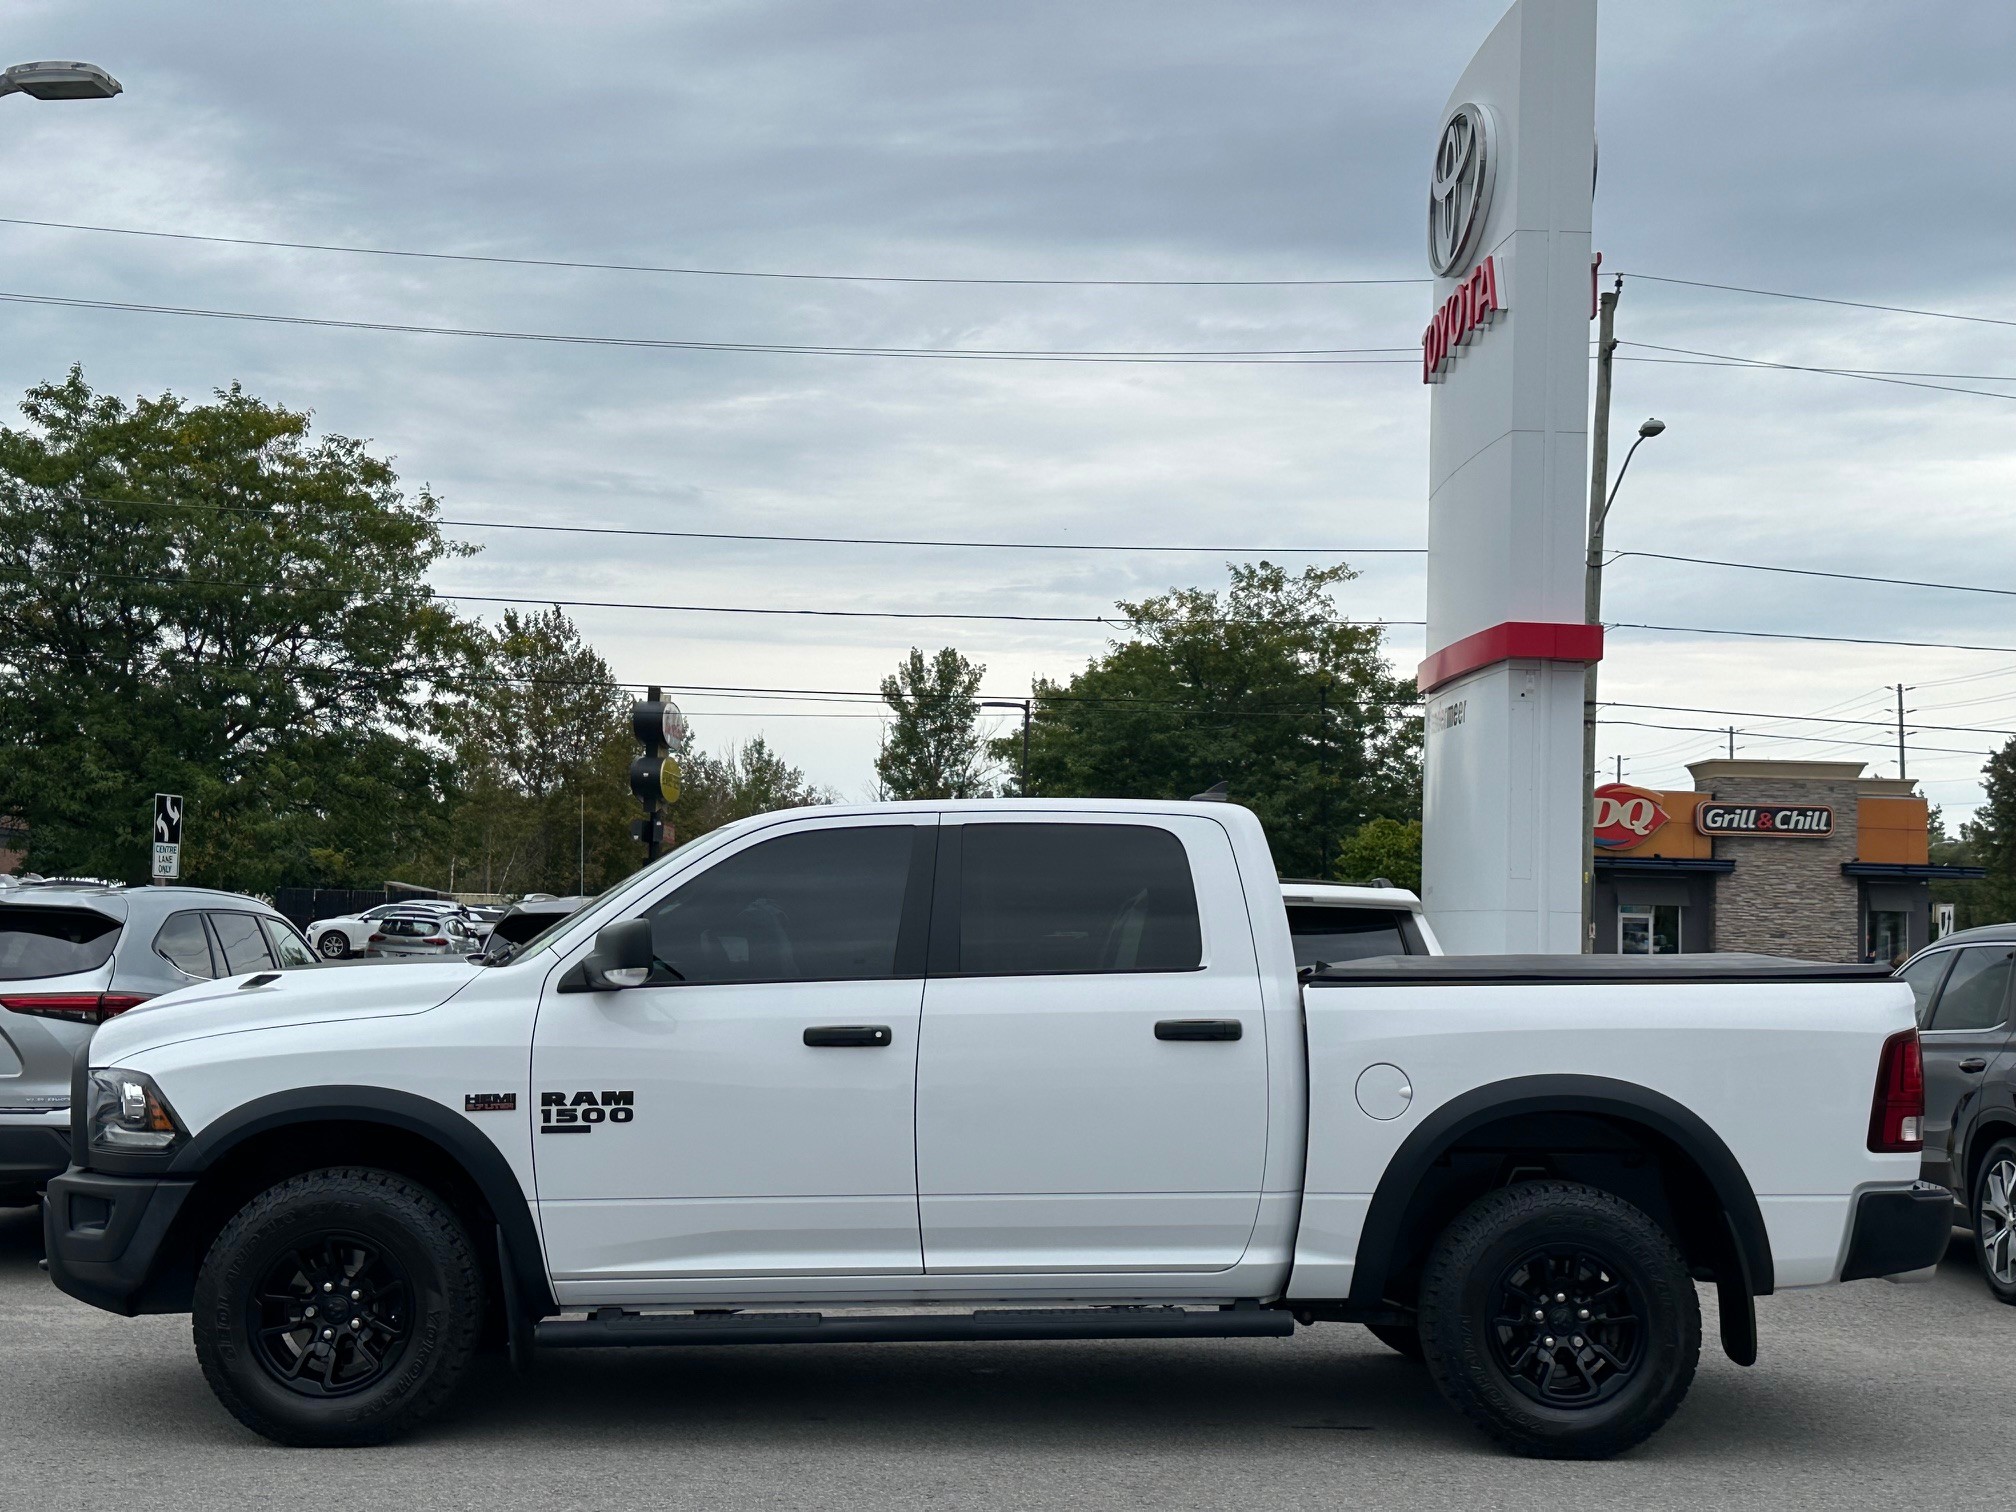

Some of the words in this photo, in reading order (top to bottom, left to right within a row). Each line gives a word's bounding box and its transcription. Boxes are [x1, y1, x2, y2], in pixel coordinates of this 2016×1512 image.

[1422, 255, 1499, 385] TOYOTA
[1594, 797, 1655, 836] DQ
[1705, 808, 1757, 830] Grill
[1757, 811, 1773, 830] &
[1774, 808, 1831, 831] Chill
[156, 845, 177, 854] CENTRE
[158, 855, 173, 864] LANE
[158, 864, 172, 874] ONLY
[465, 1093, 516, 1104] HEMI
[541, 1091, 634, 1107] RAM
[541, 1107, 634, 1123] 1500
